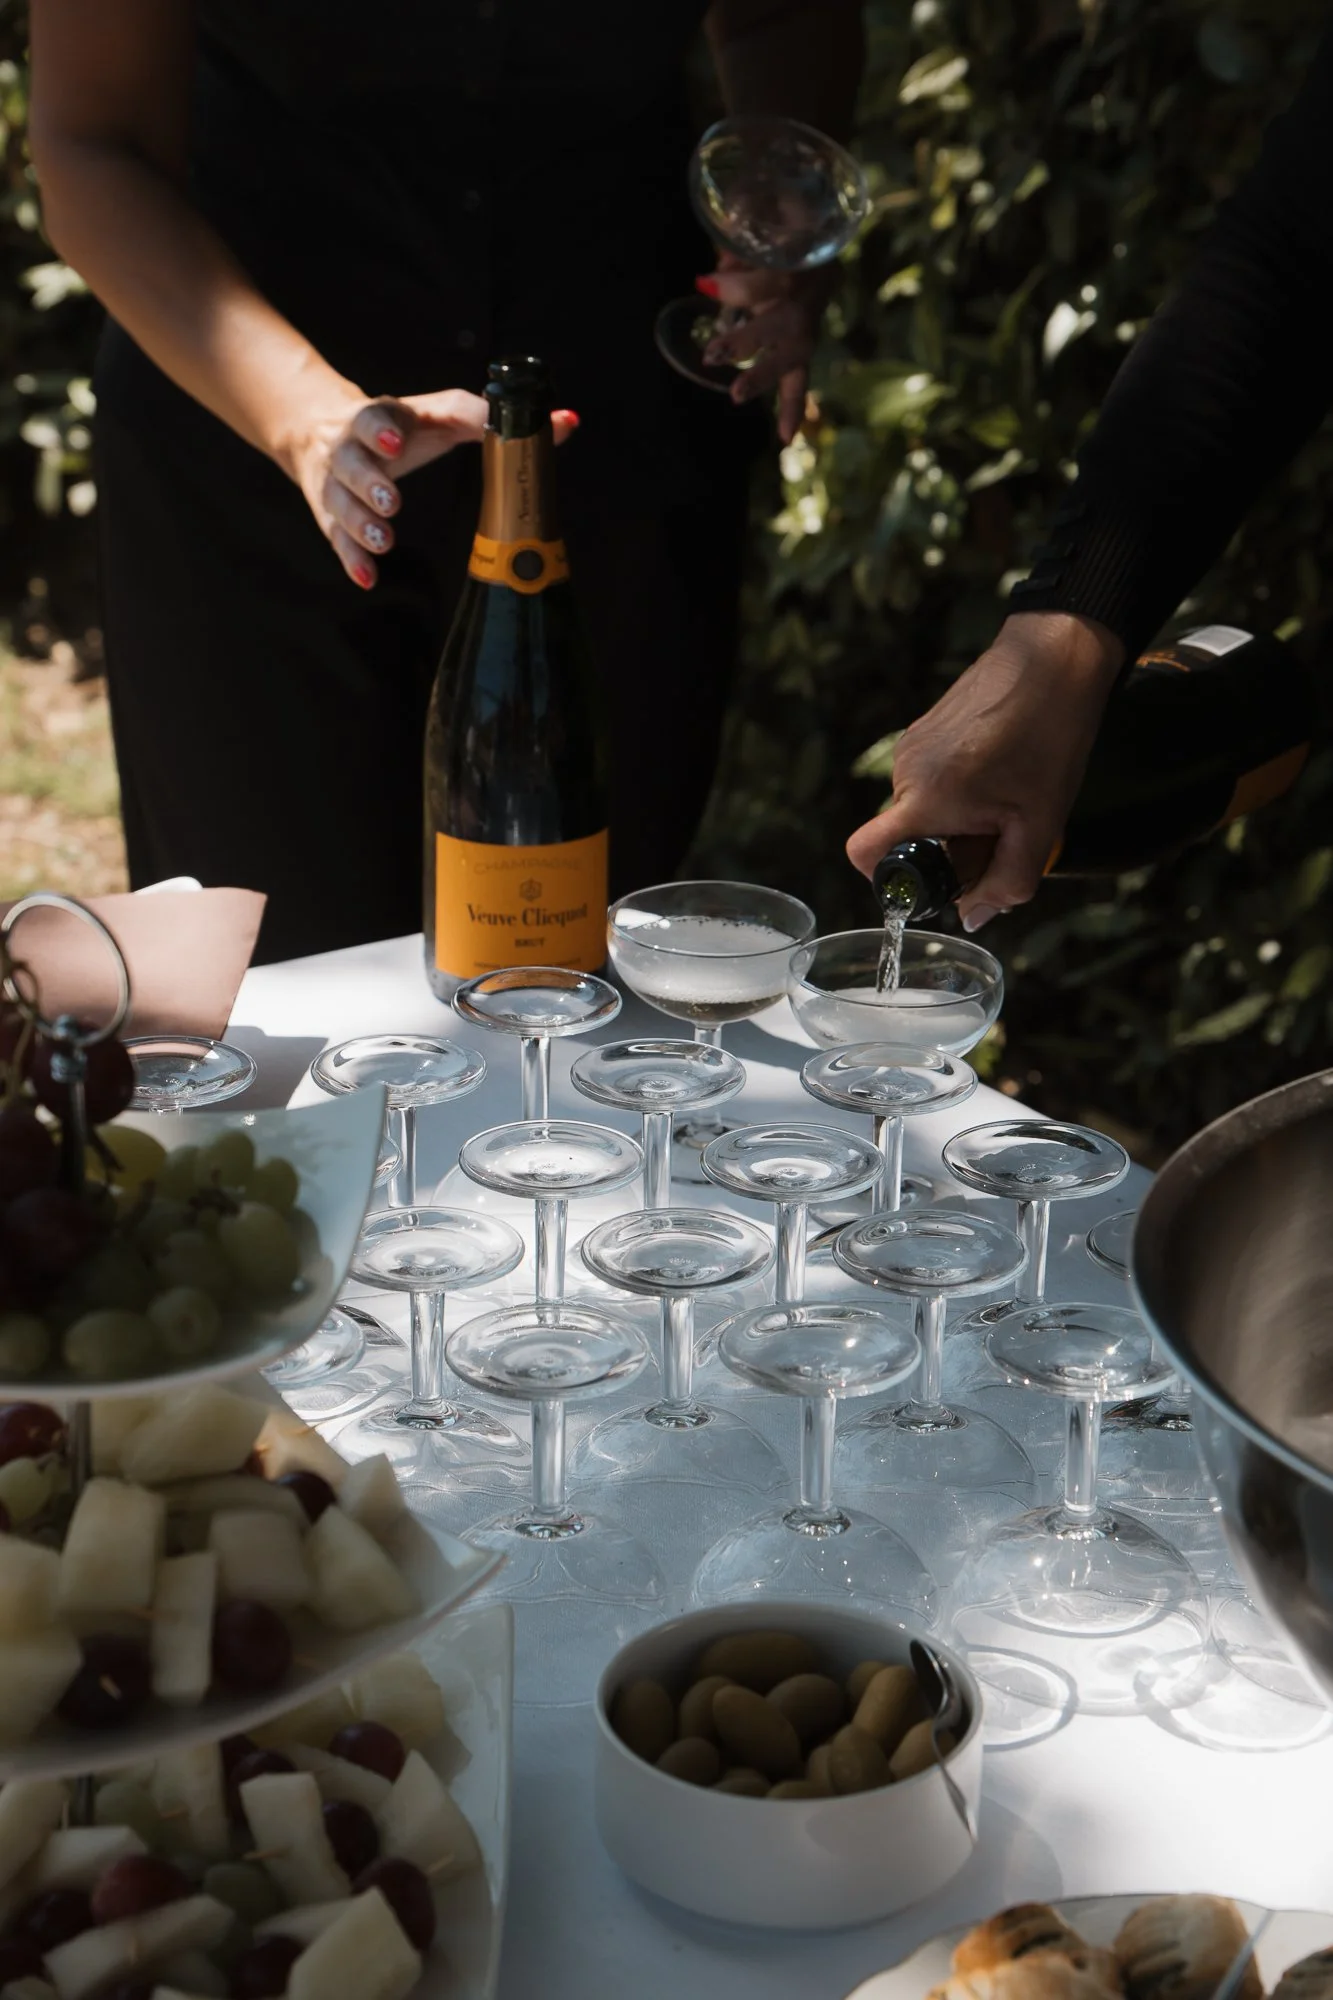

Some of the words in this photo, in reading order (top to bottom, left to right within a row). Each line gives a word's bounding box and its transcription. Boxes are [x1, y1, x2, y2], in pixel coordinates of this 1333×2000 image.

[473, 857, 582, 875] CHAMPAGNE
[466, 902, 518, 927] Veuve
[521, 902, 588, 928] Clicquot
